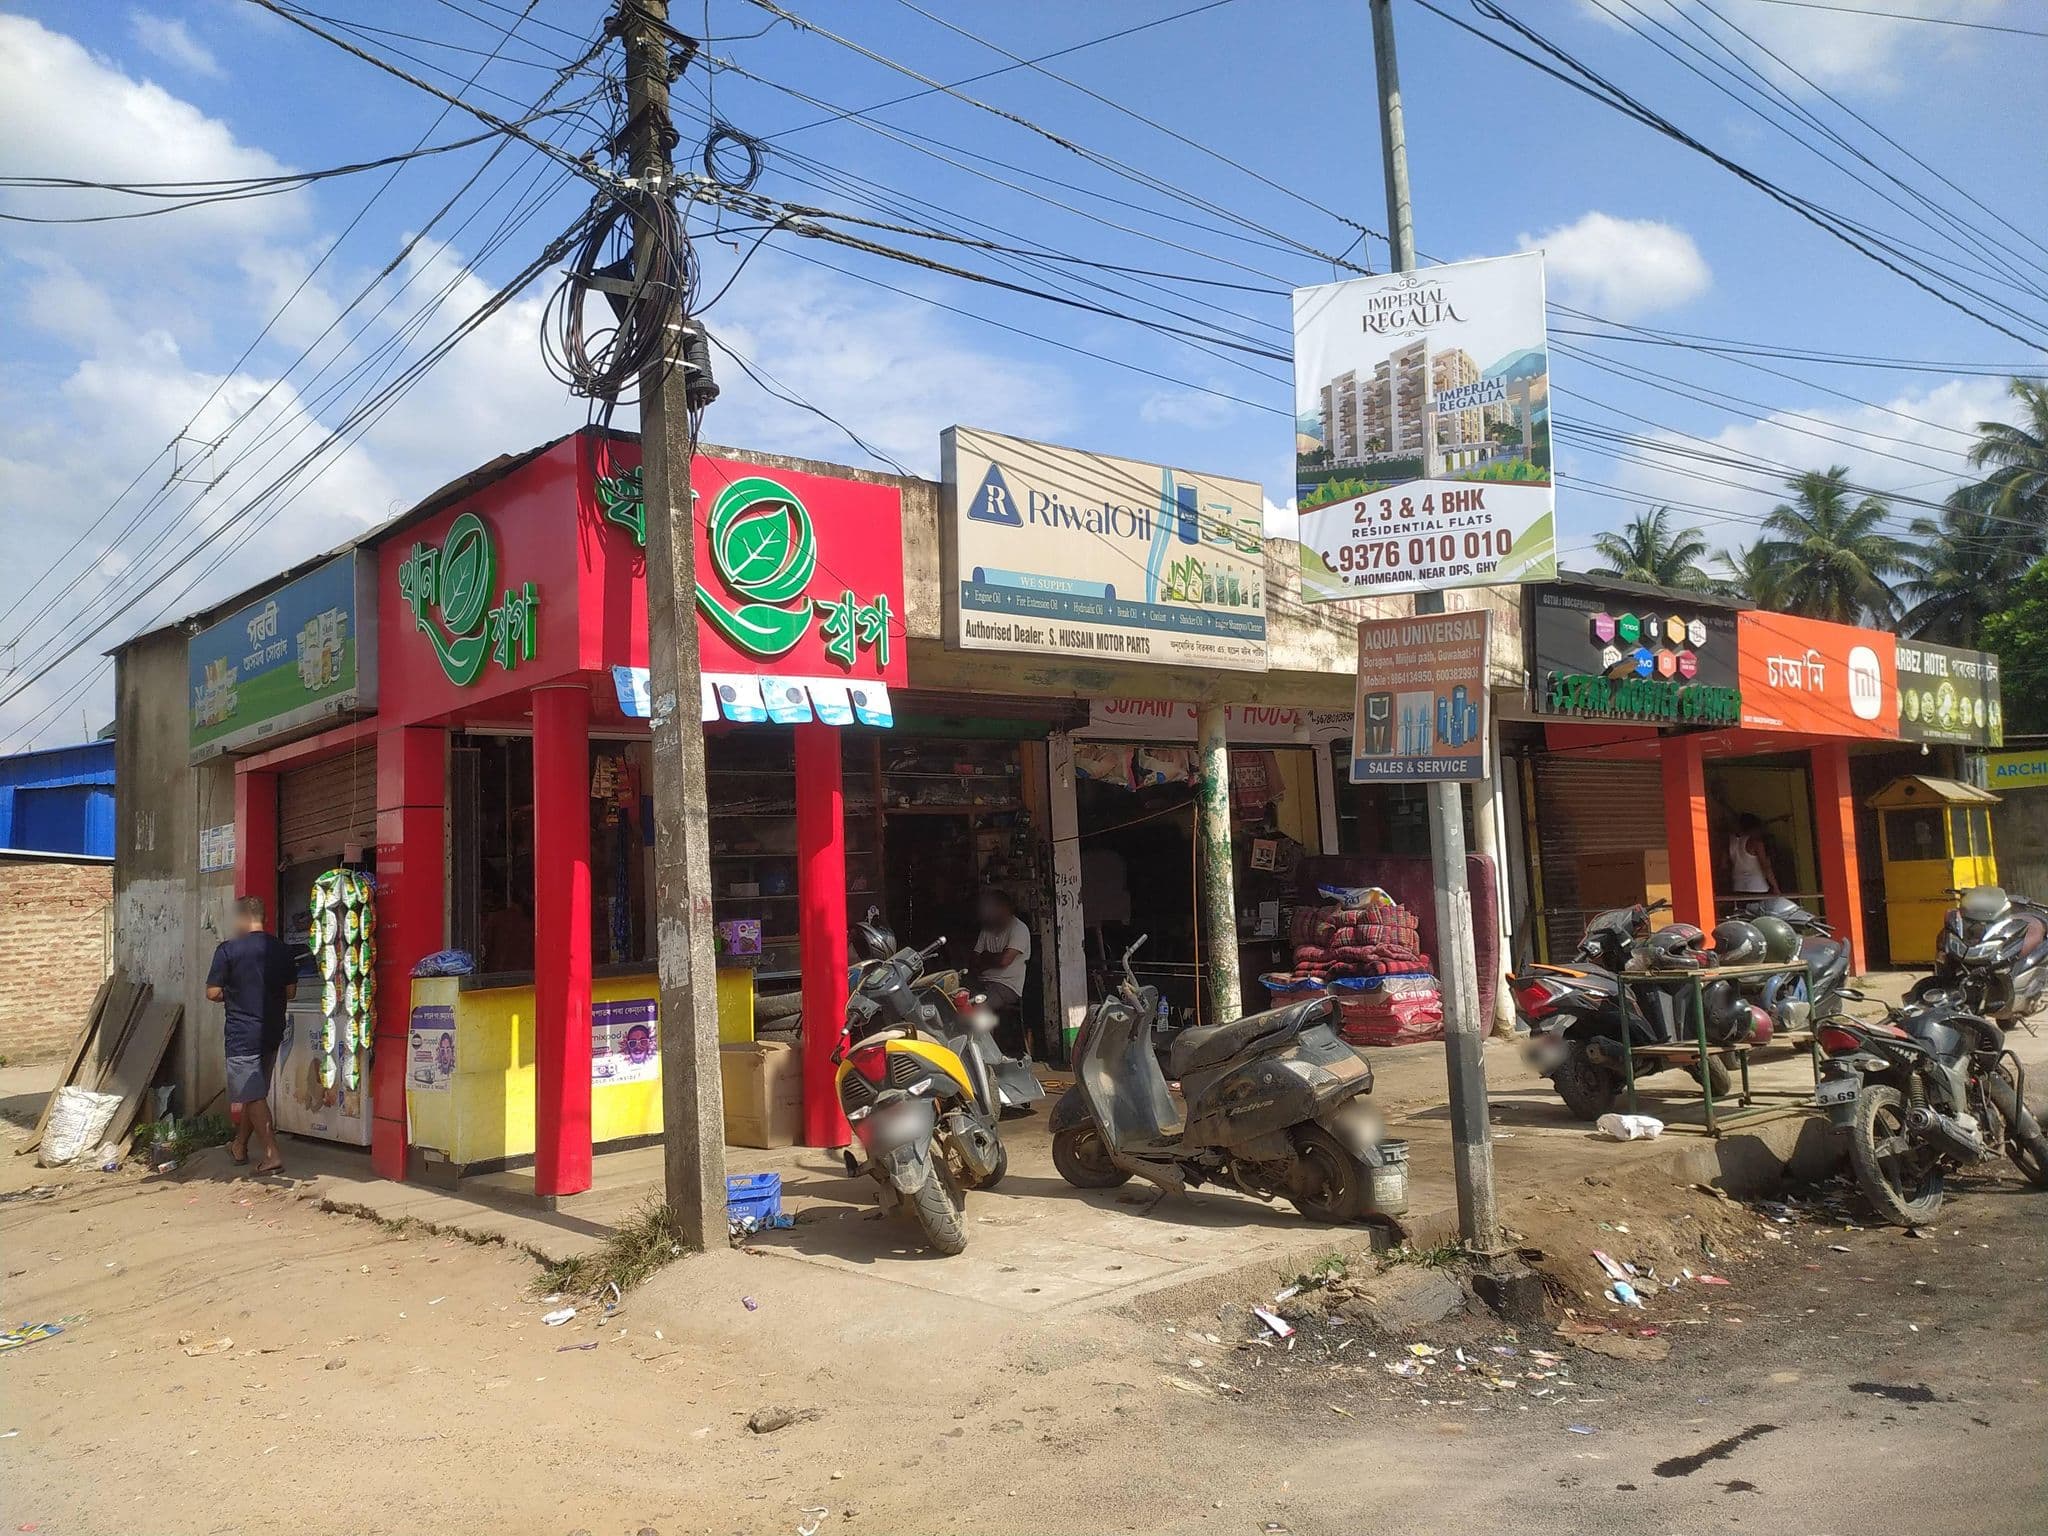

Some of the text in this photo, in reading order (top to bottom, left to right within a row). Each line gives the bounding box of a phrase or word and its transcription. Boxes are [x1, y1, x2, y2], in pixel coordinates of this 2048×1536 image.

[1368, 287, 1448, 313] IMPERIAL
[1362, 303, 1467, 334] REGALIA
[1439, 376, 1506, 402] IMPERIAL
[1439, 389, 1506, 413] REGALIA
[1028, 489, 1152, 542] RiwalOil
[1354, 488, 1485, 527] 2, 3 & 4 BHK
[1352, 514, 1493, 539] RESIDENTIAL FLATS
[1339, 528, 1513, 573] 9376 010 010
[1019, 576, 1074, 592] WE SUPPLY
[1354, 560, 1498, 587] AHOMGAON, NEAR DPS, GHY
[974, 590, 993, 605] Engine
[965, 618, 1151, 655] Authorised Dealer: S. HUSSAIN MOTOR PARTS
[1365, 618, 1481, 651] AQUA UNIVERSAL
[1895, 646, 1949, 678] ARBEZ HOTEL
[1368, 759, 1468, 774] SALES & SERVICE
